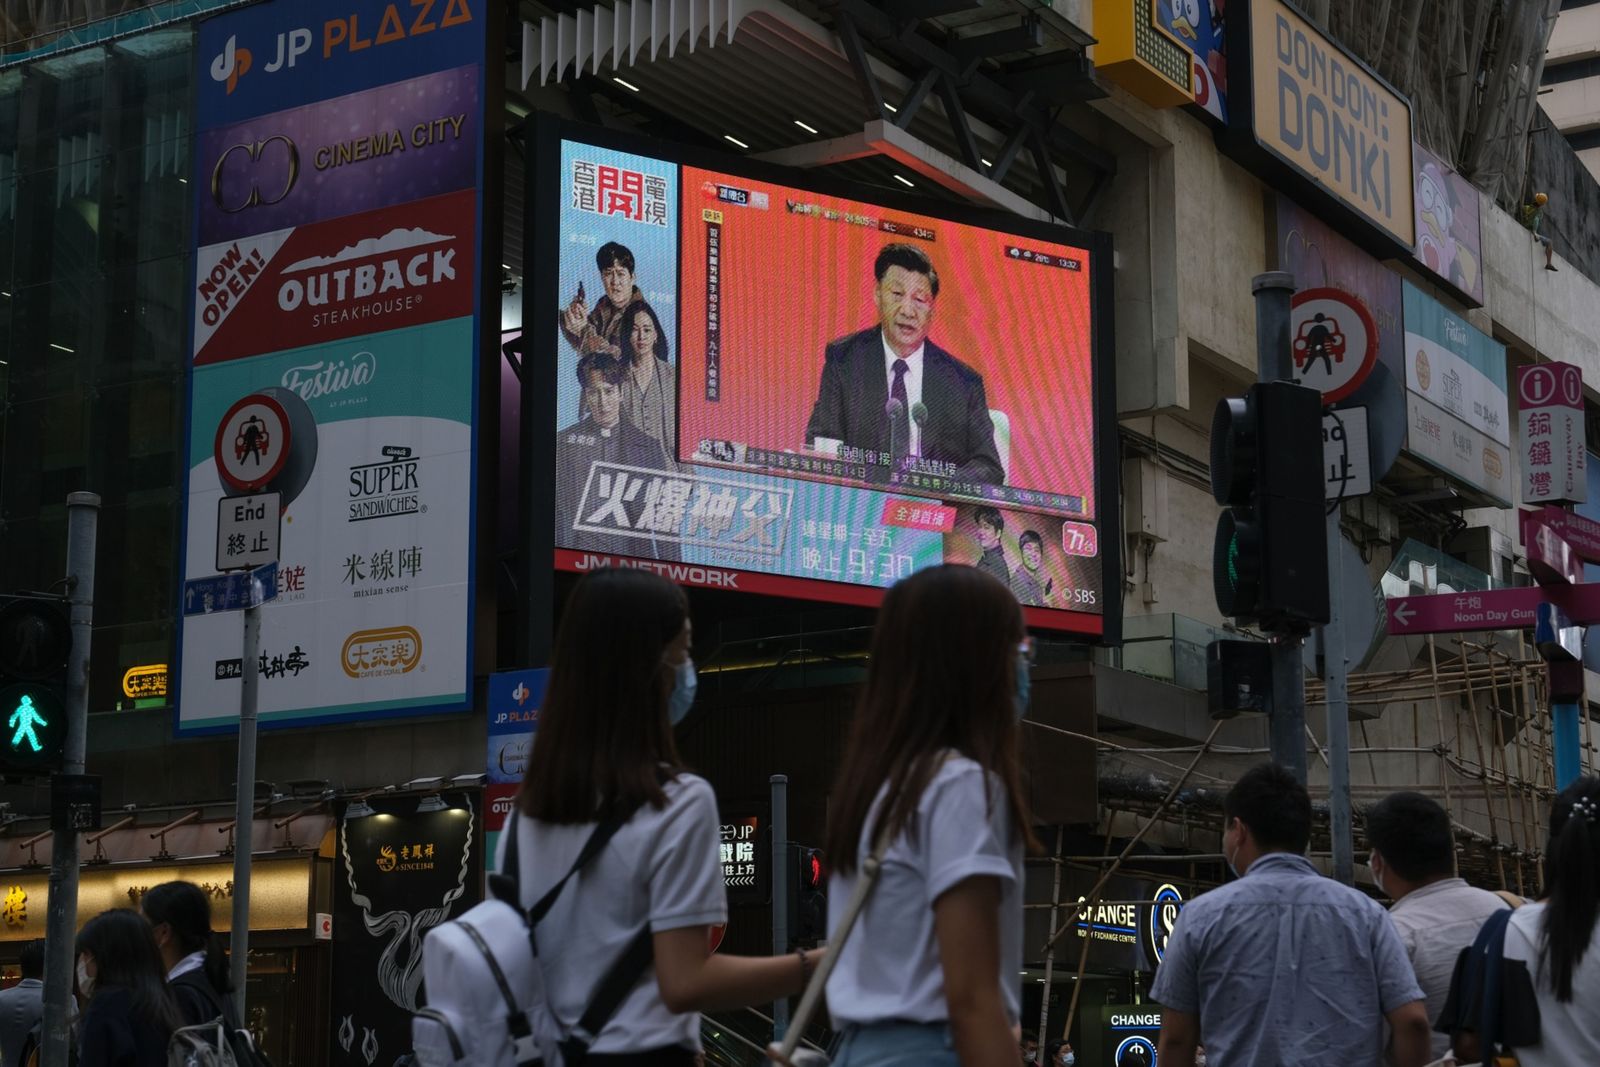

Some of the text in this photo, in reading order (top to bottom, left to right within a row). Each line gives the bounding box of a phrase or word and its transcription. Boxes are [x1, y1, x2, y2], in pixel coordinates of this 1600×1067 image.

[263, 0, 473, 73] JP PLAZA
[314, 113, 466, 170] CINEMA CITY
[1278, 67, 1393, 220] DONKI
[198, 242, 242, 303] NOW
[277, 248, 456, 312] OUTBACK
[202, 248, 266, 327] OPEN!
[281, 351, 376, 401] Festiva
[1527, 411, 1552, 497] 銅鑼灣
[349, 462, 419, 497] SUPER
[234, 504, 265, 522] End
[349, 495, 418, 519] SANDWICHES
[586, 472, 783, 547] 火爆神父
[895, 507, 944, 526] 全港首播
[227, 531, 270, 557] 終止
[342, 545, 423, 586] 米線陣
[575, 554, 611, 571] JM
[802, 547, 842, 574] 晚上
[353, 584, 409, 598] mixian sense
[1454, 596, 1482, 610] 午炮
[1454, 609, 1535, 622] Noon Day Gun
[495, 710, 538, 723] JP PLAZ
[737, 825, 754, 840] JP
[720, 864, 755, 876] 往上方
[1094, 931, 1118, 942] EXCHANGE
[1119, 933, 1136, 943] CENTRE
[1111, 1014, 1161, 1026] CHANGE
